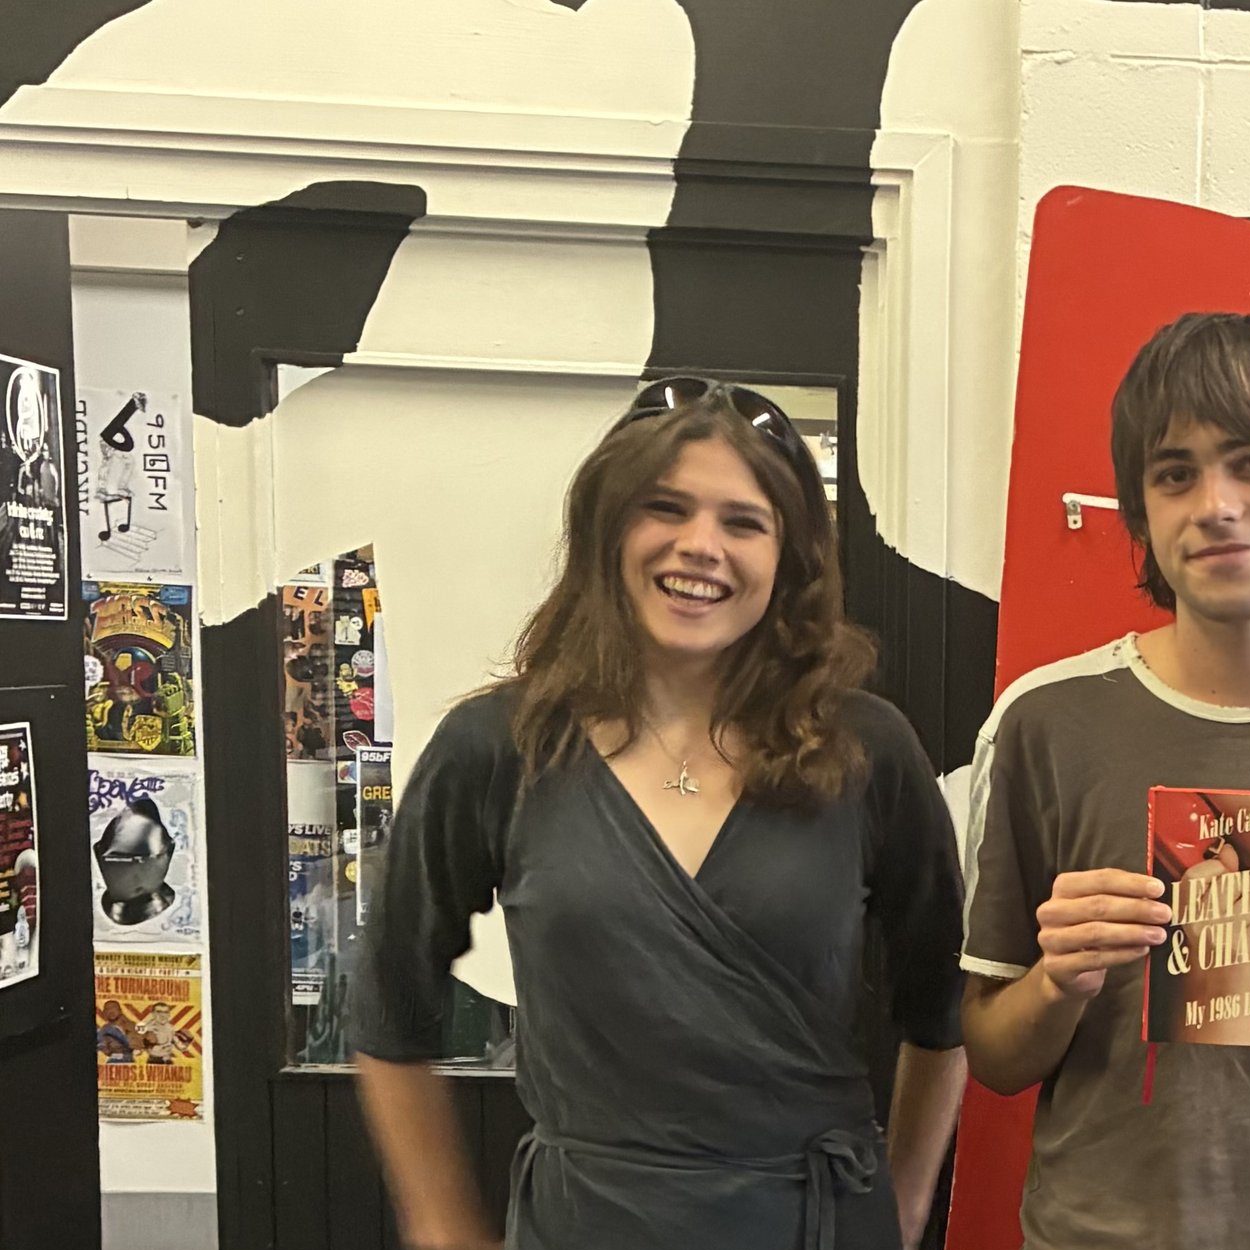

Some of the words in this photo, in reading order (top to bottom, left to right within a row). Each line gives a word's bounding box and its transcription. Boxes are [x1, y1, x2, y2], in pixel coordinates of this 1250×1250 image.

[1199, 811, 1233, 840] Kate
[1167, 929, 1192, 976] &
[113, 977, 189, 997] TURNAROUND
[1185, 1001, 1205, 1029] My
[1210, 995, 1240, 1023] 1986
